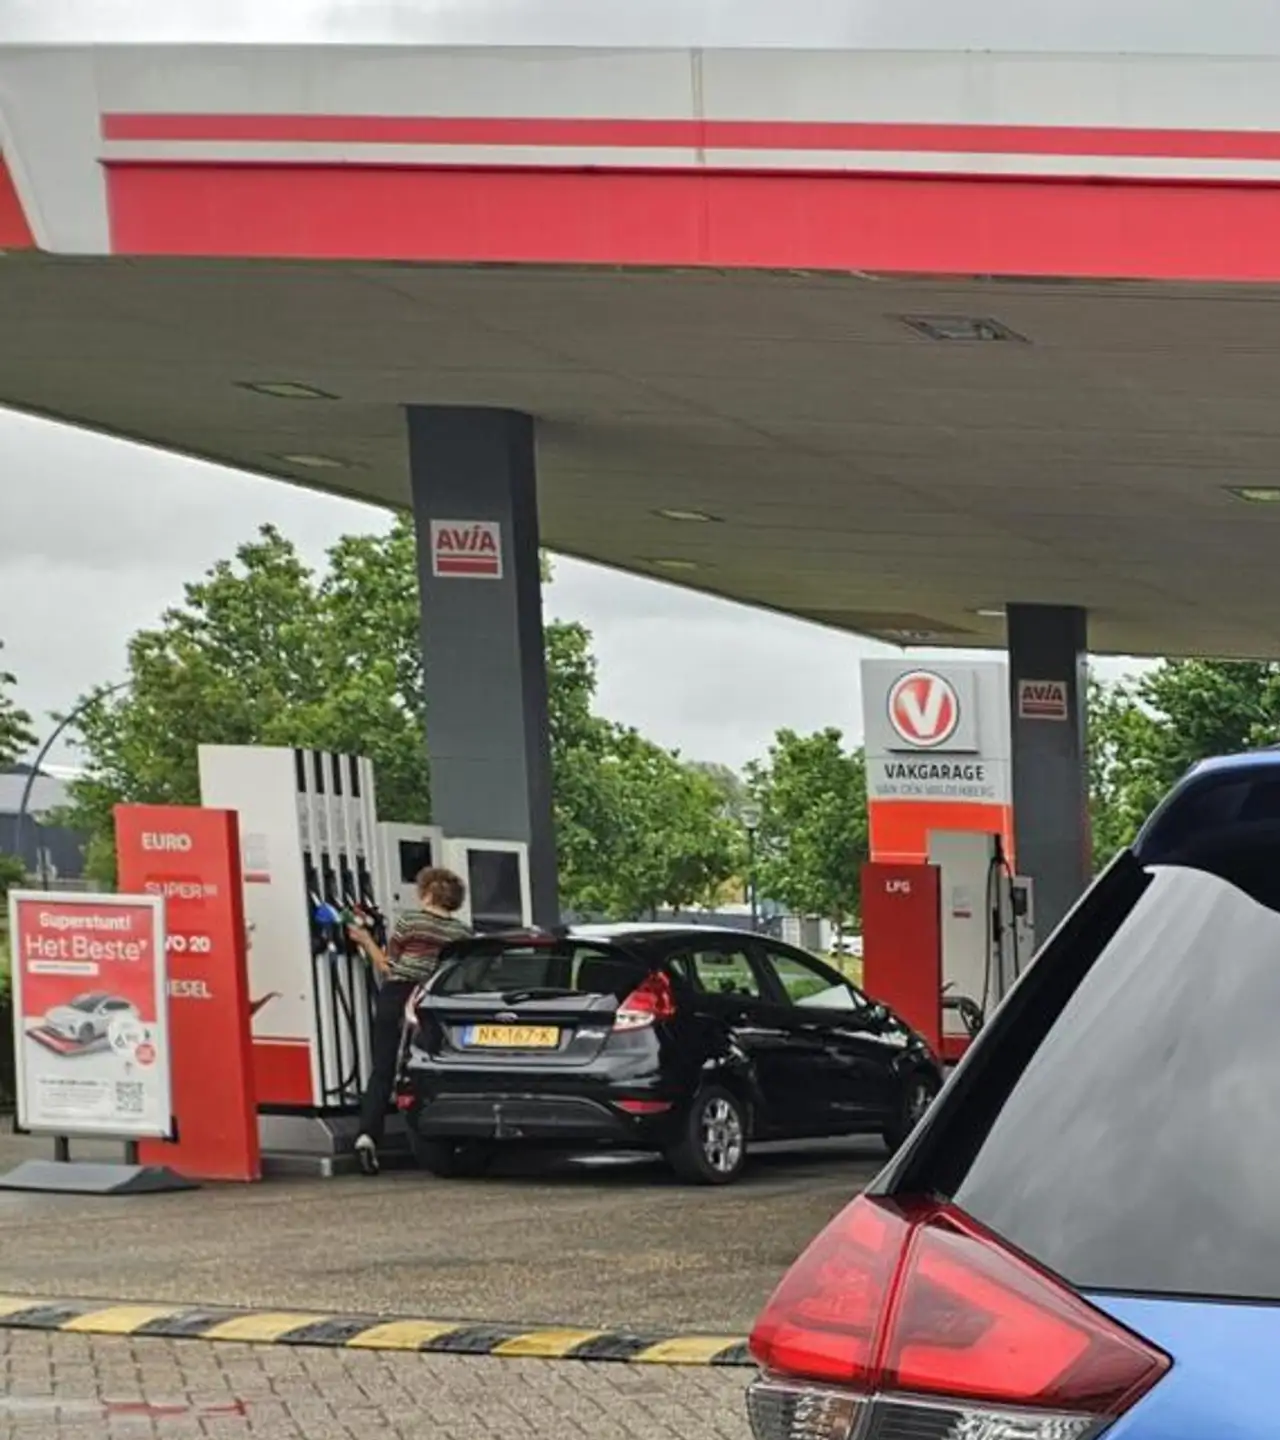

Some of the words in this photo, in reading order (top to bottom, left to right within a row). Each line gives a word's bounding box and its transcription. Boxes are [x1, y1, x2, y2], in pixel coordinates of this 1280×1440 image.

[437, 524, 497, 552] AVIA
[1023, 684, 1063, 701] AVIA
[884, 763, 984, 781] VAKGARAGE
[876, 783, 897, 795] VAN
[142, 832, 192, 852] EURO
[886, 880, 911, 893] LPG
[26, 933, 69, 958] Het
[189, 936, 211, 952] 20
[166, 980, 212, 998] IESEL
